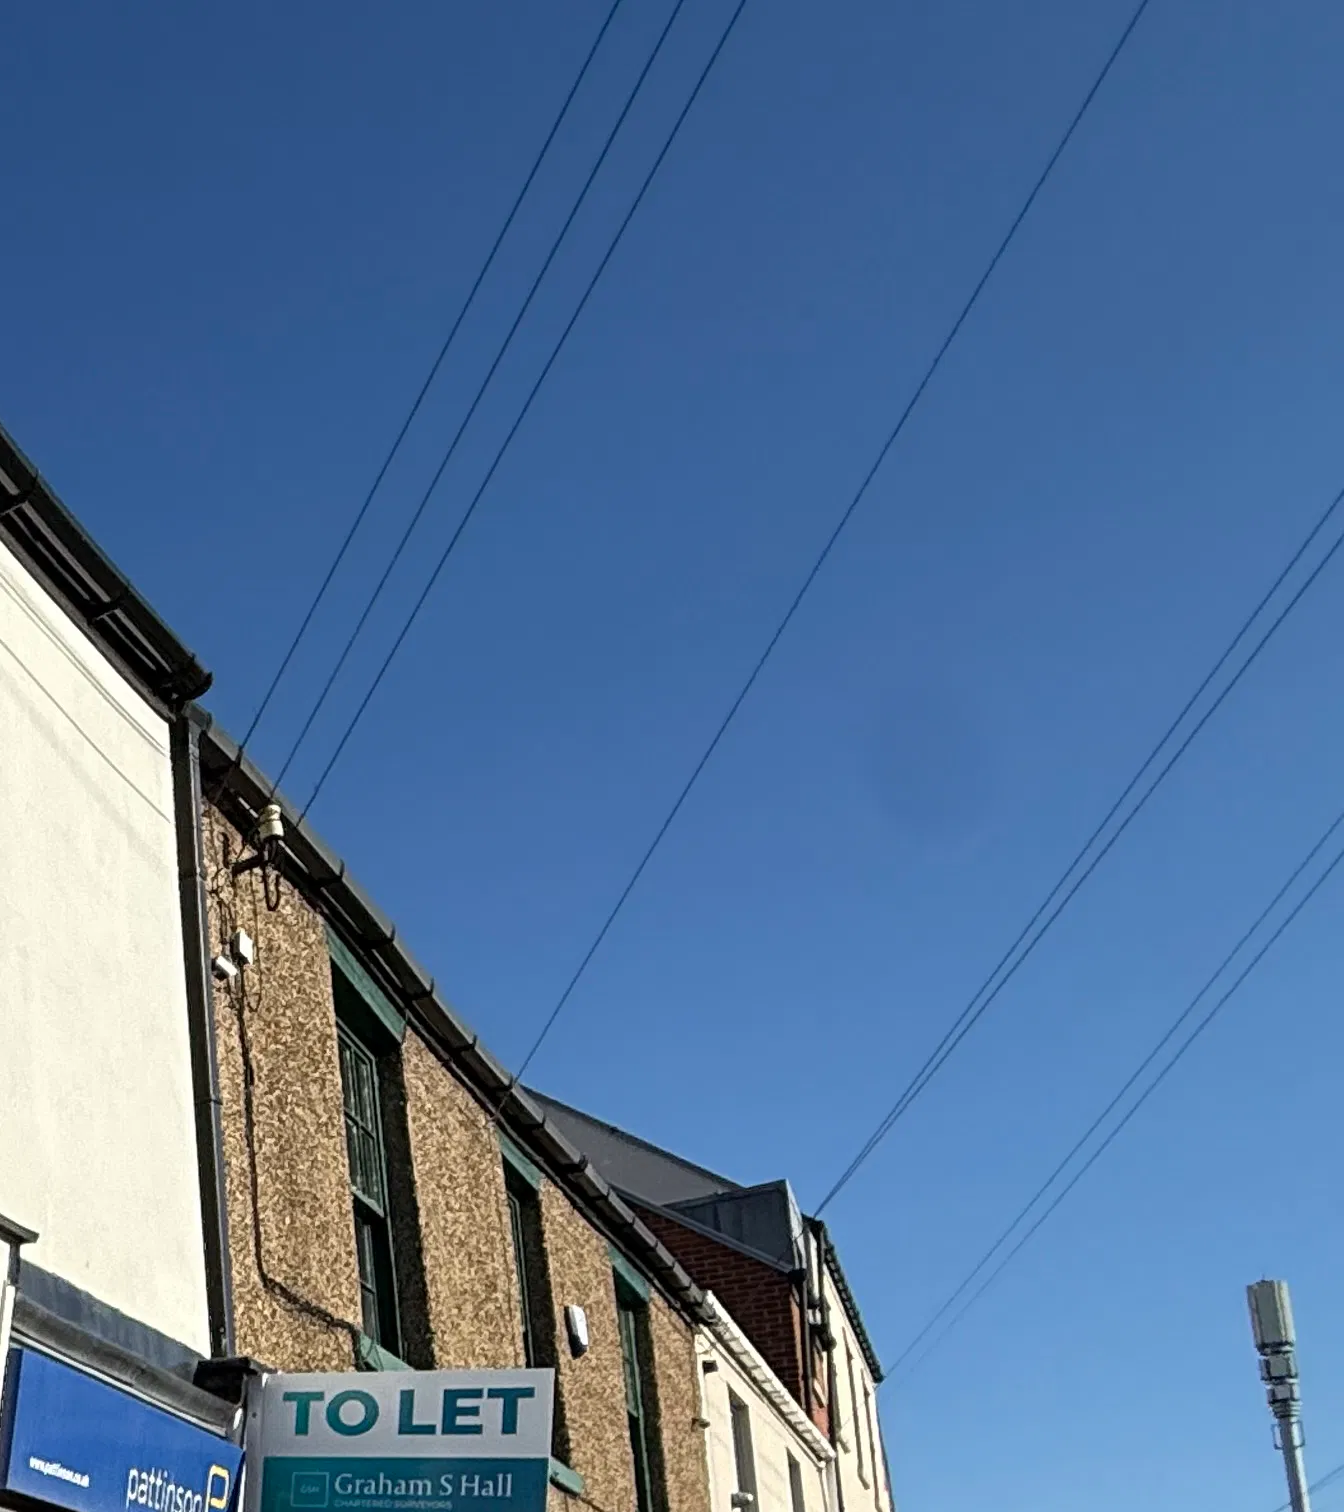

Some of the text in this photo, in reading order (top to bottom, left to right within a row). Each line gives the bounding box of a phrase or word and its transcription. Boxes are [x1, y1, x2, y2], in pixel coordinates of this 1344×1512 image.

[283, 1386, 535, 1436] TO LET
[334, 1472, 513, 1497] Graham S Hall
